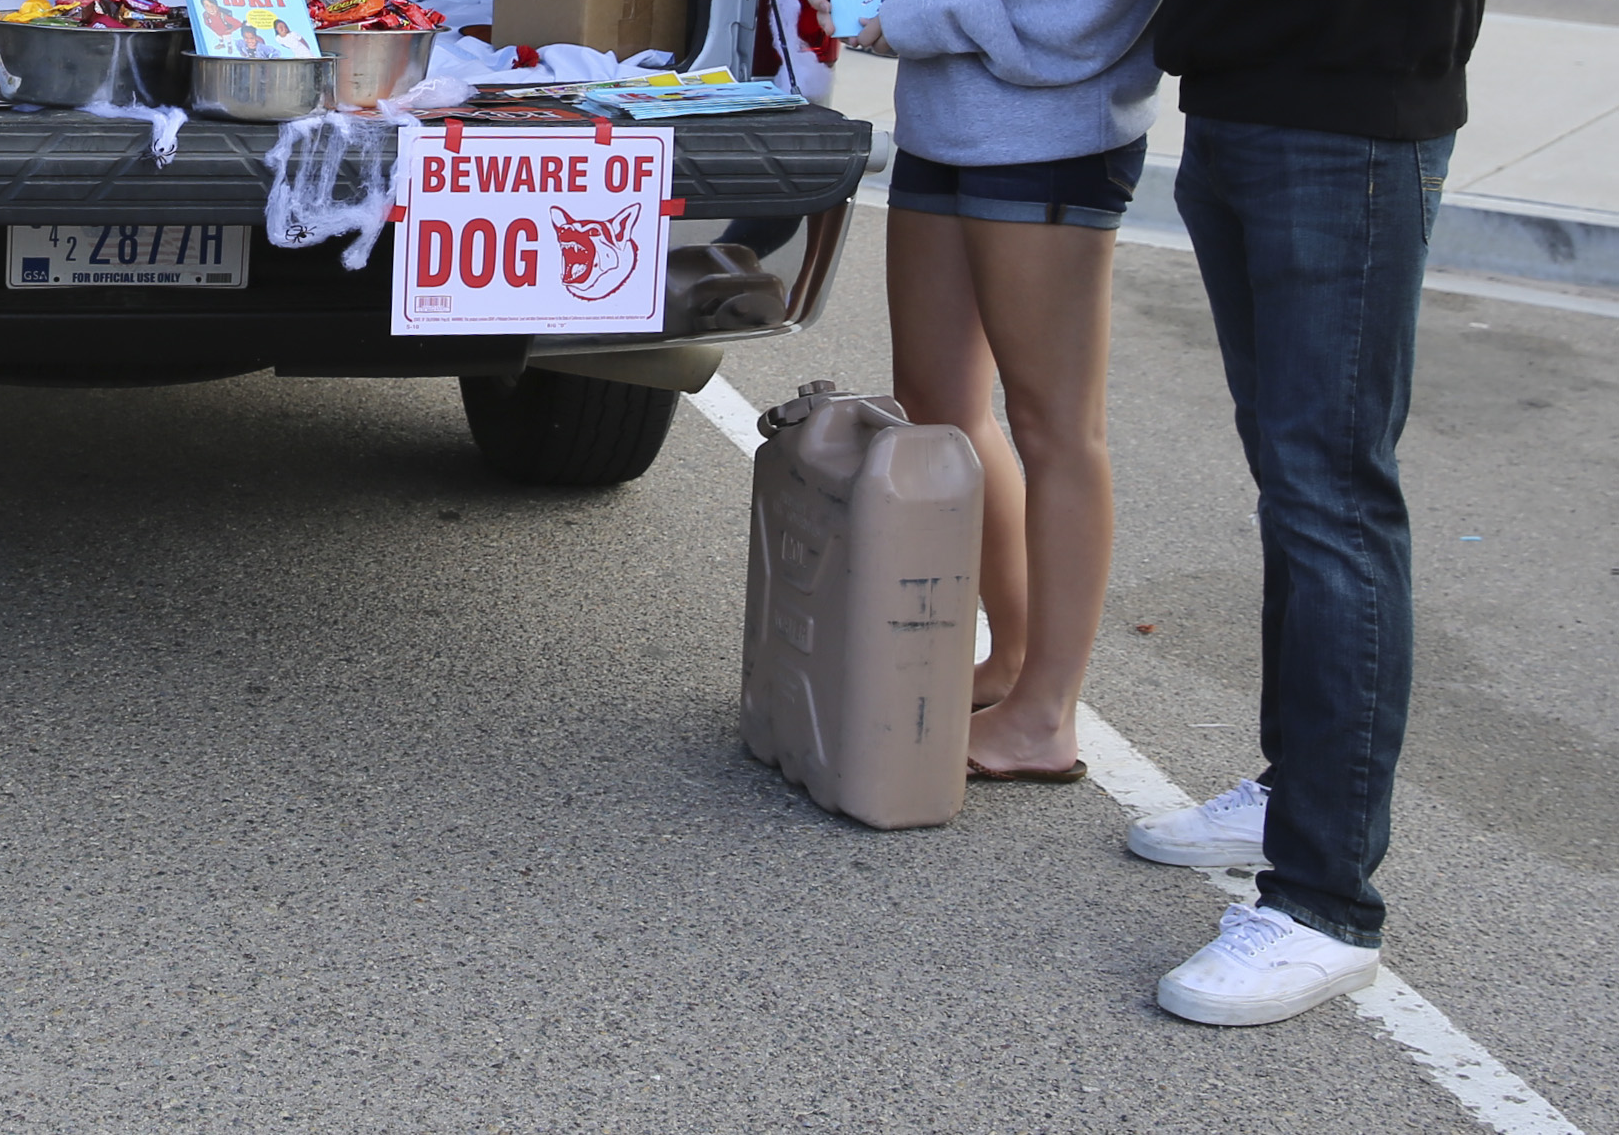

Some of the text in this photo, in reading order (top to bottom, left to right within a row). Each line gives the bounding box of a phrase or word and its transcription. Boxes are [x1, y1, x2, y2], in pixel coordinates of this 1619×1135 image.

[422, 155, 654, 193] BEWARE OF
[416, 218, 539, 289] DOG
[23, 270, 48, 280] GSA
[72, 272, 181, 283] FOR OFFICIAL USE ONLY
